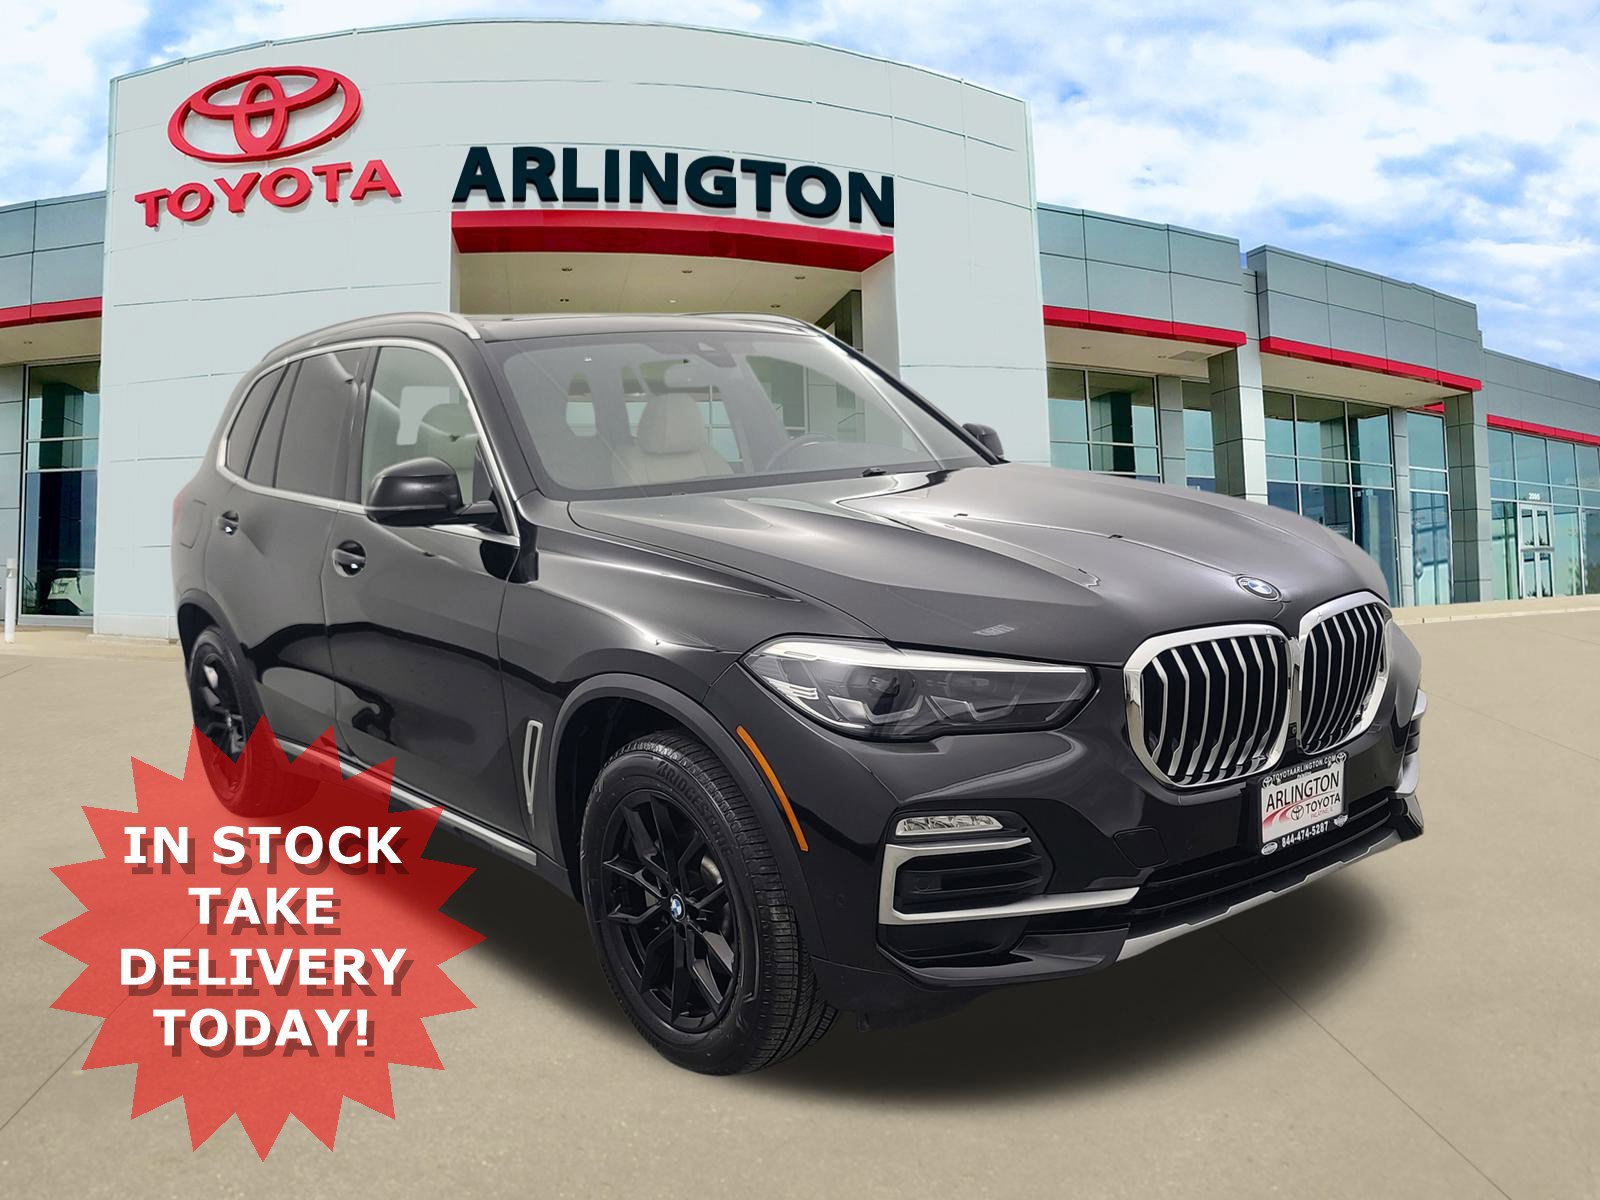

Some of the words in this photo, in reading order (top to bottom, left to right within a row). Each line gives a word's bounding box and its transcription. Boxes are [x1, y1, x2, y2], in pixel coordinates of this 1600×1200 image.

[135, 159, 402, 228] TOYOTA
[452, 146, 895, 228] ARLINGTON
[1265, 771, 1340, 813] ARLINGTON
[1305, 792, 1341, 814] TOYOTA
[1281, 820, 1329, 848] 844-474-5287
